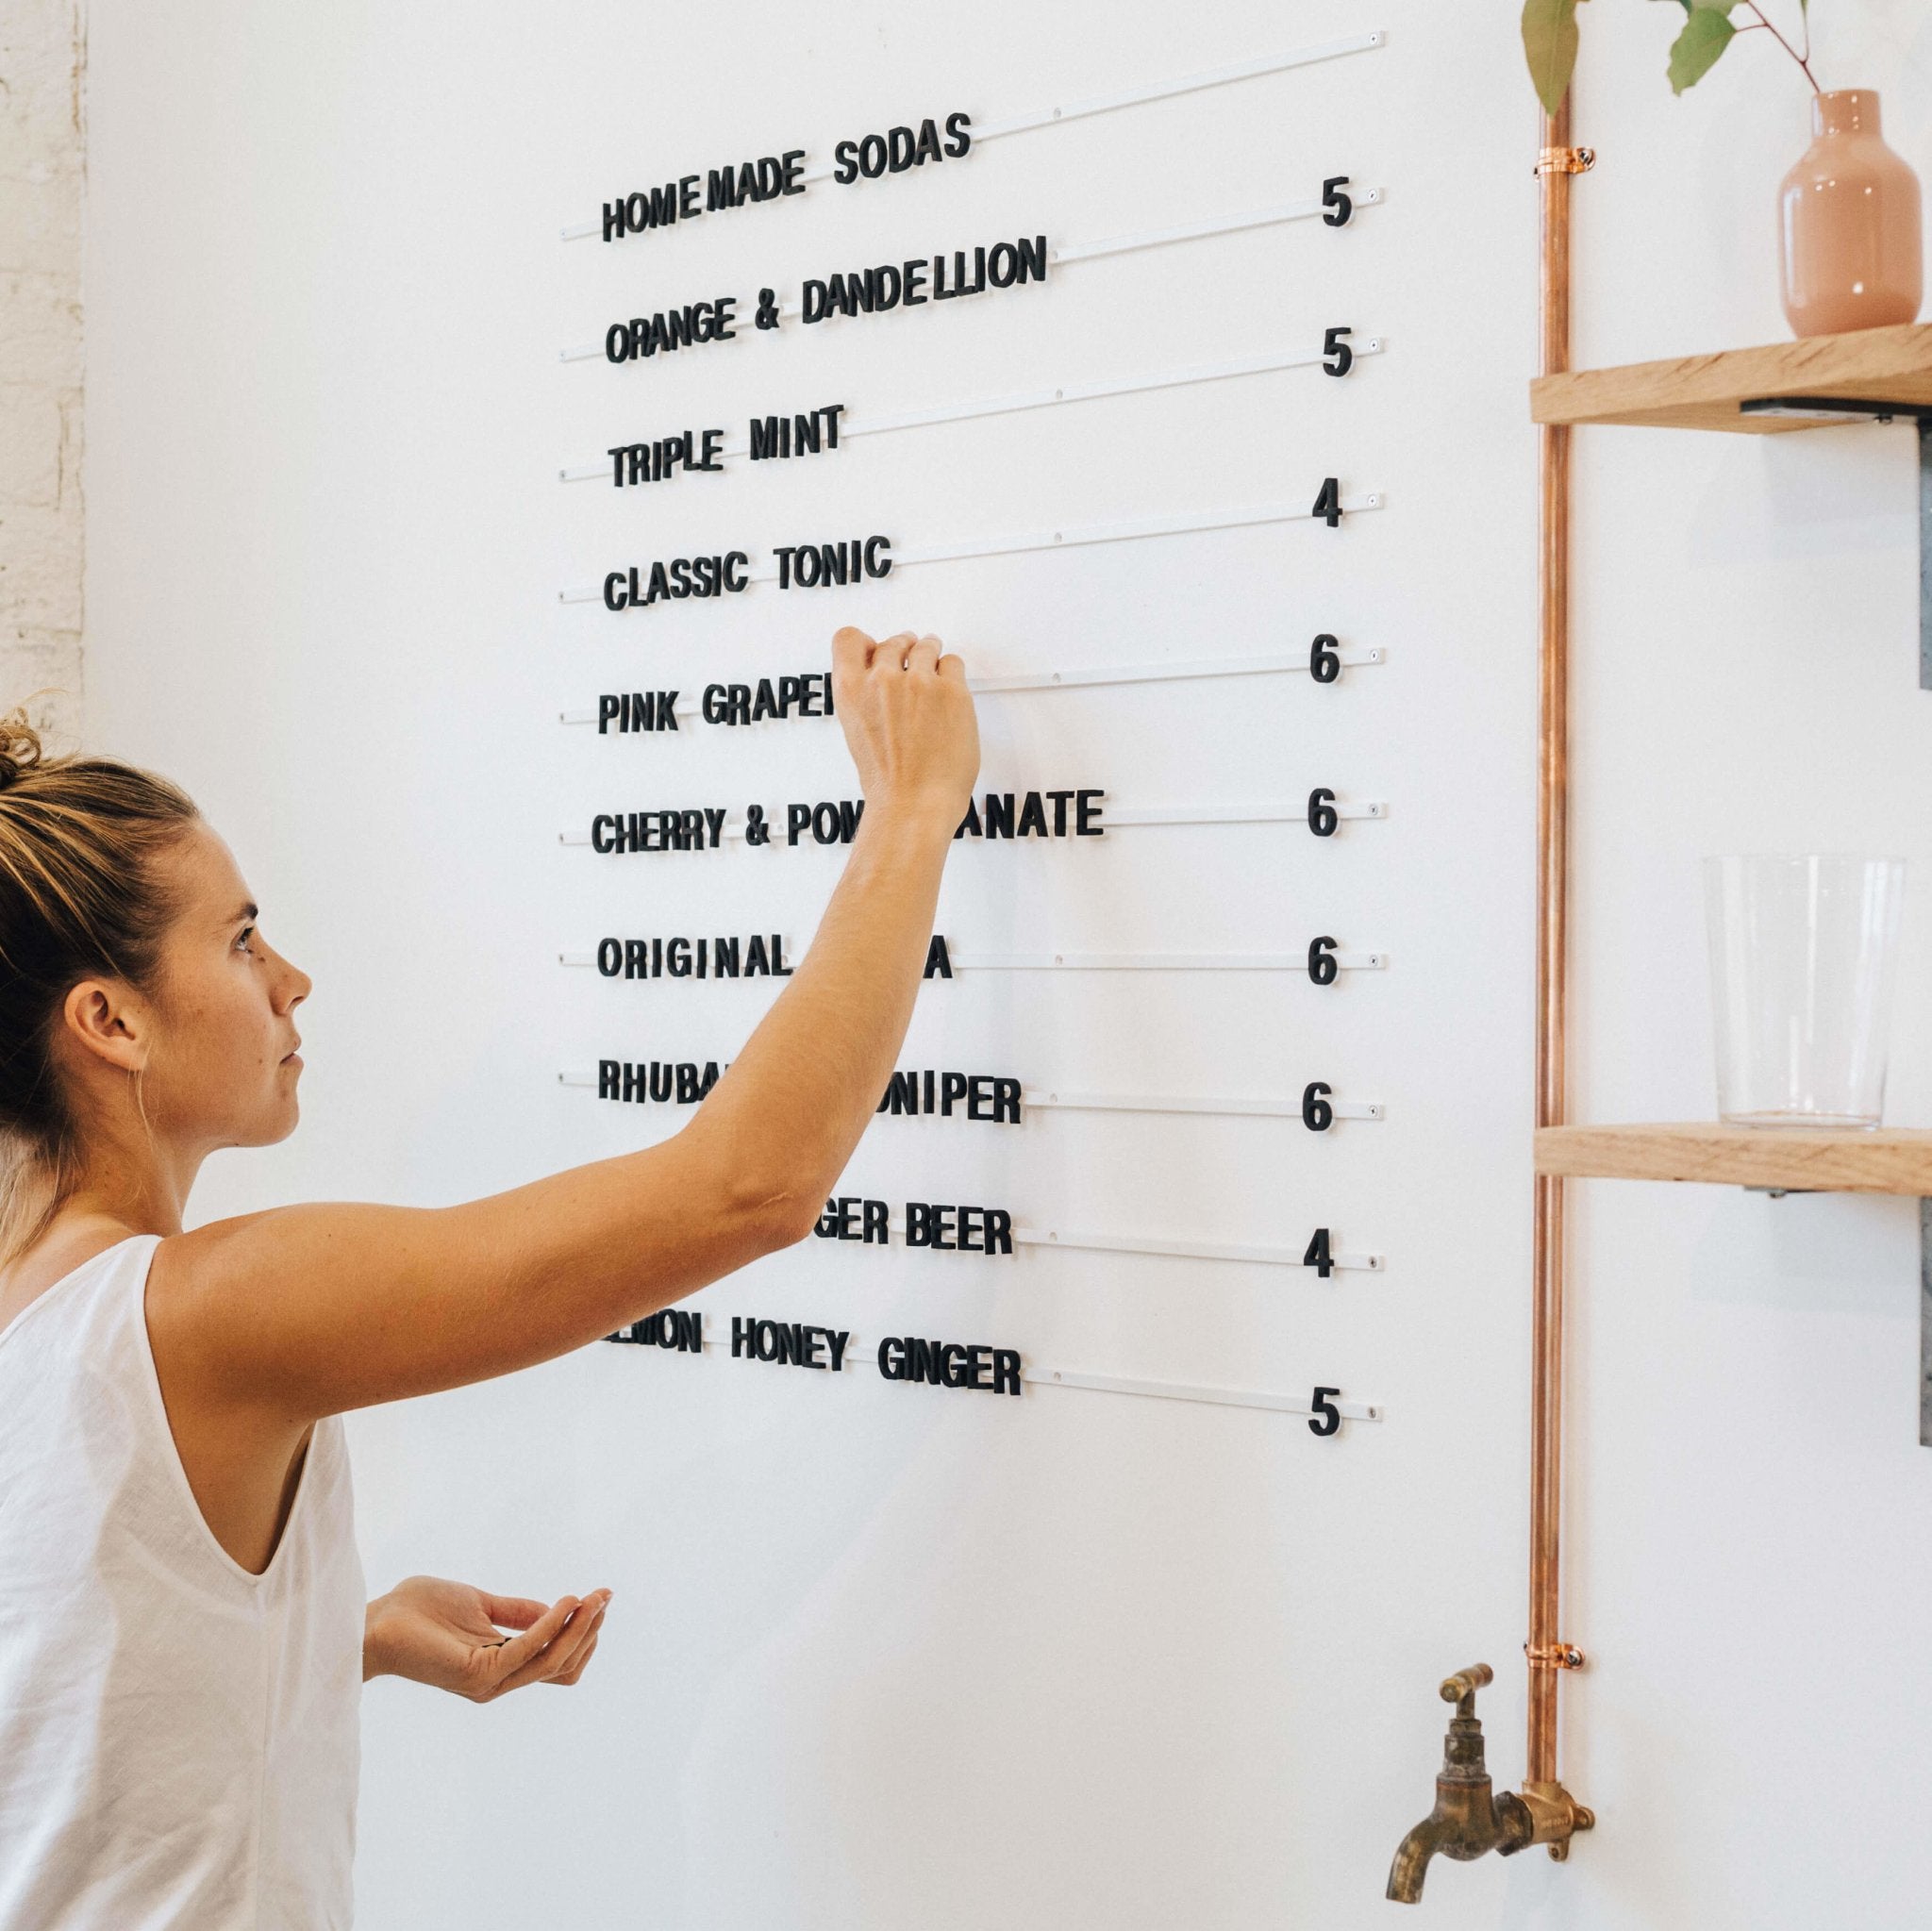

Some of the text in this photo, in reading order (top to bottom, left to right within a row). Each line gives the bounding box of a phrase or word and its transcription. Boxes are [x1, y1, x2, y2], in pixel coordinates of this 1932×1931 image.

[604, 112, 972, 242] HOMEMADE SODAS
[606, 176, 1352, 364] ORANGE & DANDELLION 5
[608, 326, 1353, 488] TRIPLE MINT 5
[604, 477, 1343, 612] CLASSIC TONIC 4
[598, 691, 679, 735] PINK
[1309, 634, 1340, 684] 6
[591, 807, 726, 854] CHERRY
[745, 804, 771, 847] &
[1307, 788, 1338, 838] 6
[597, 934, 1338, 986] ORIGINAL 6
[598, 1059, 732, 1105] RHUBA
[1302, 1082, 1333, 1132] 6
[813, 1197, 1335, 1278] GER BEER 4
[731, 1316, 850, 1373] HONEY
[877, 1337, 1022, 1396] GINGER
[1307, 1387, 1341, 1437] 5
